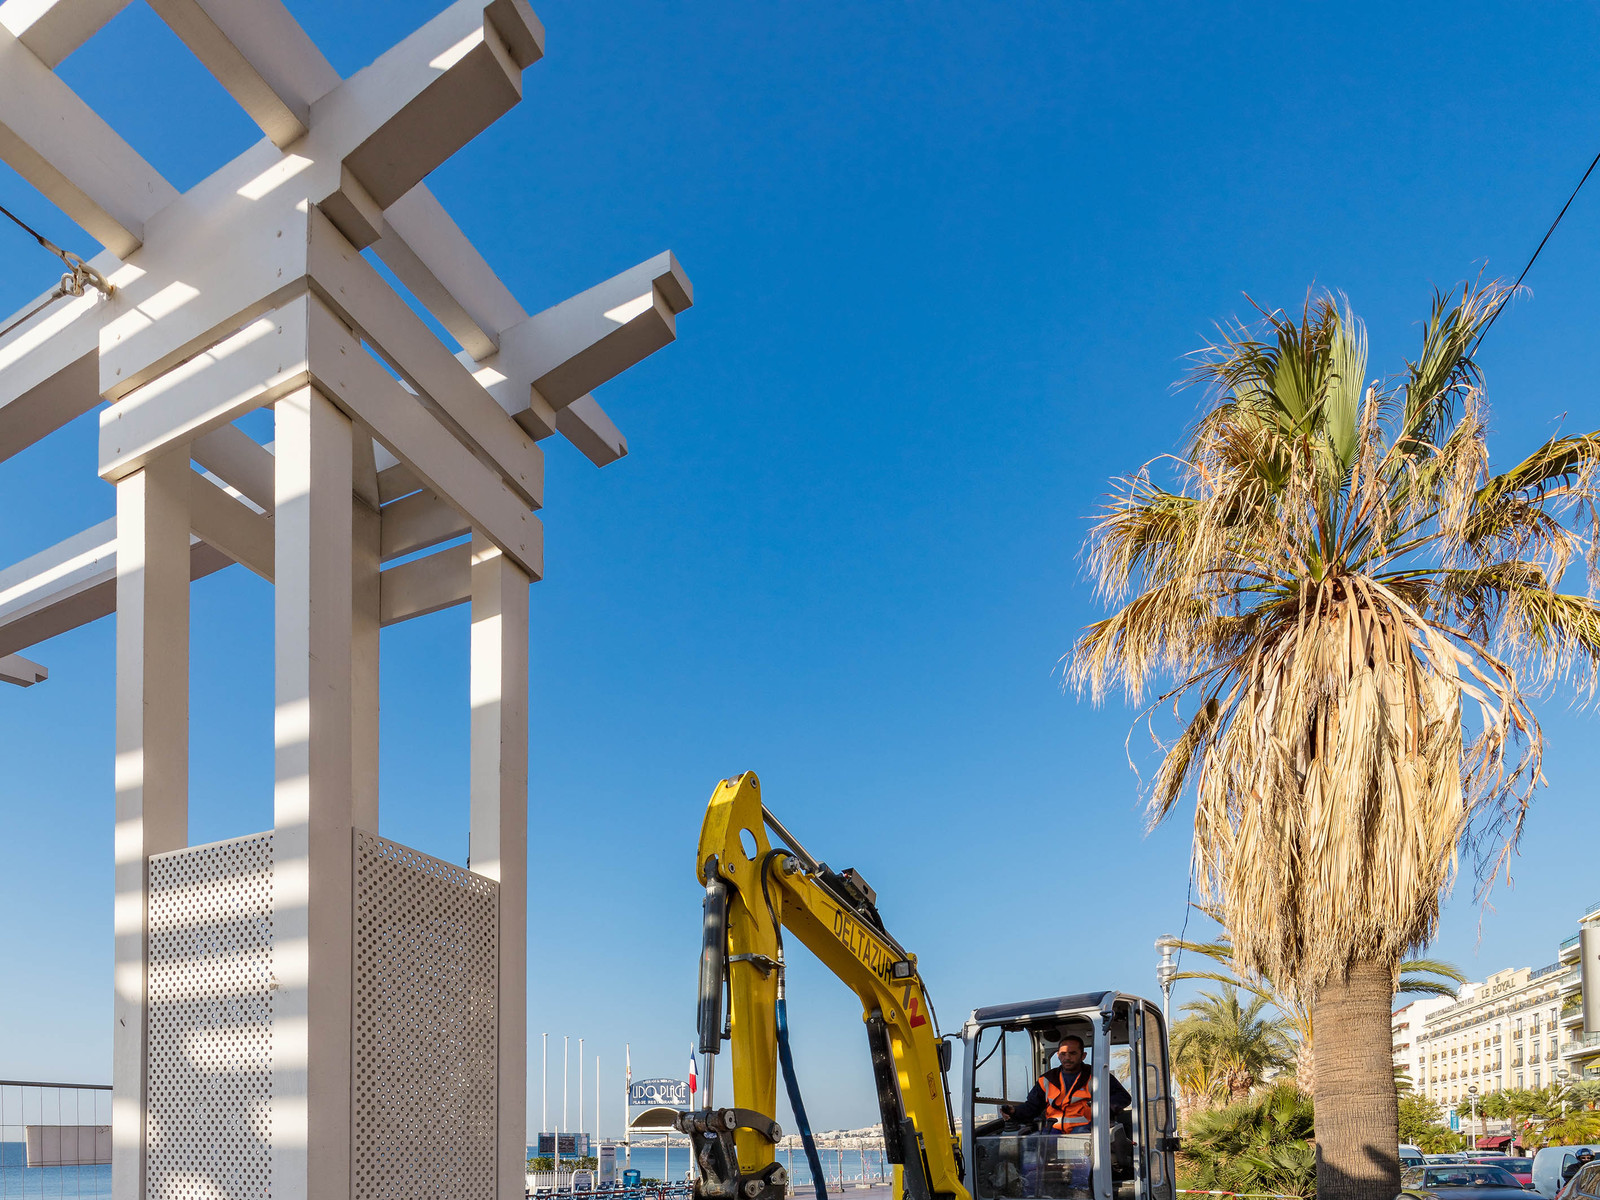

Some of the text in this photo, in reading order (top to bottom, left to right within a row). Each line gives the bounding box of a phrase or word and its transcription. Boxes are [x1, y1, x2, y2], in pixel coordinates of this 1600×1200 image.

[833, 909, 893, 985] DELTAZUR
[1481, 978, 1516, 999] LE ROYAL
